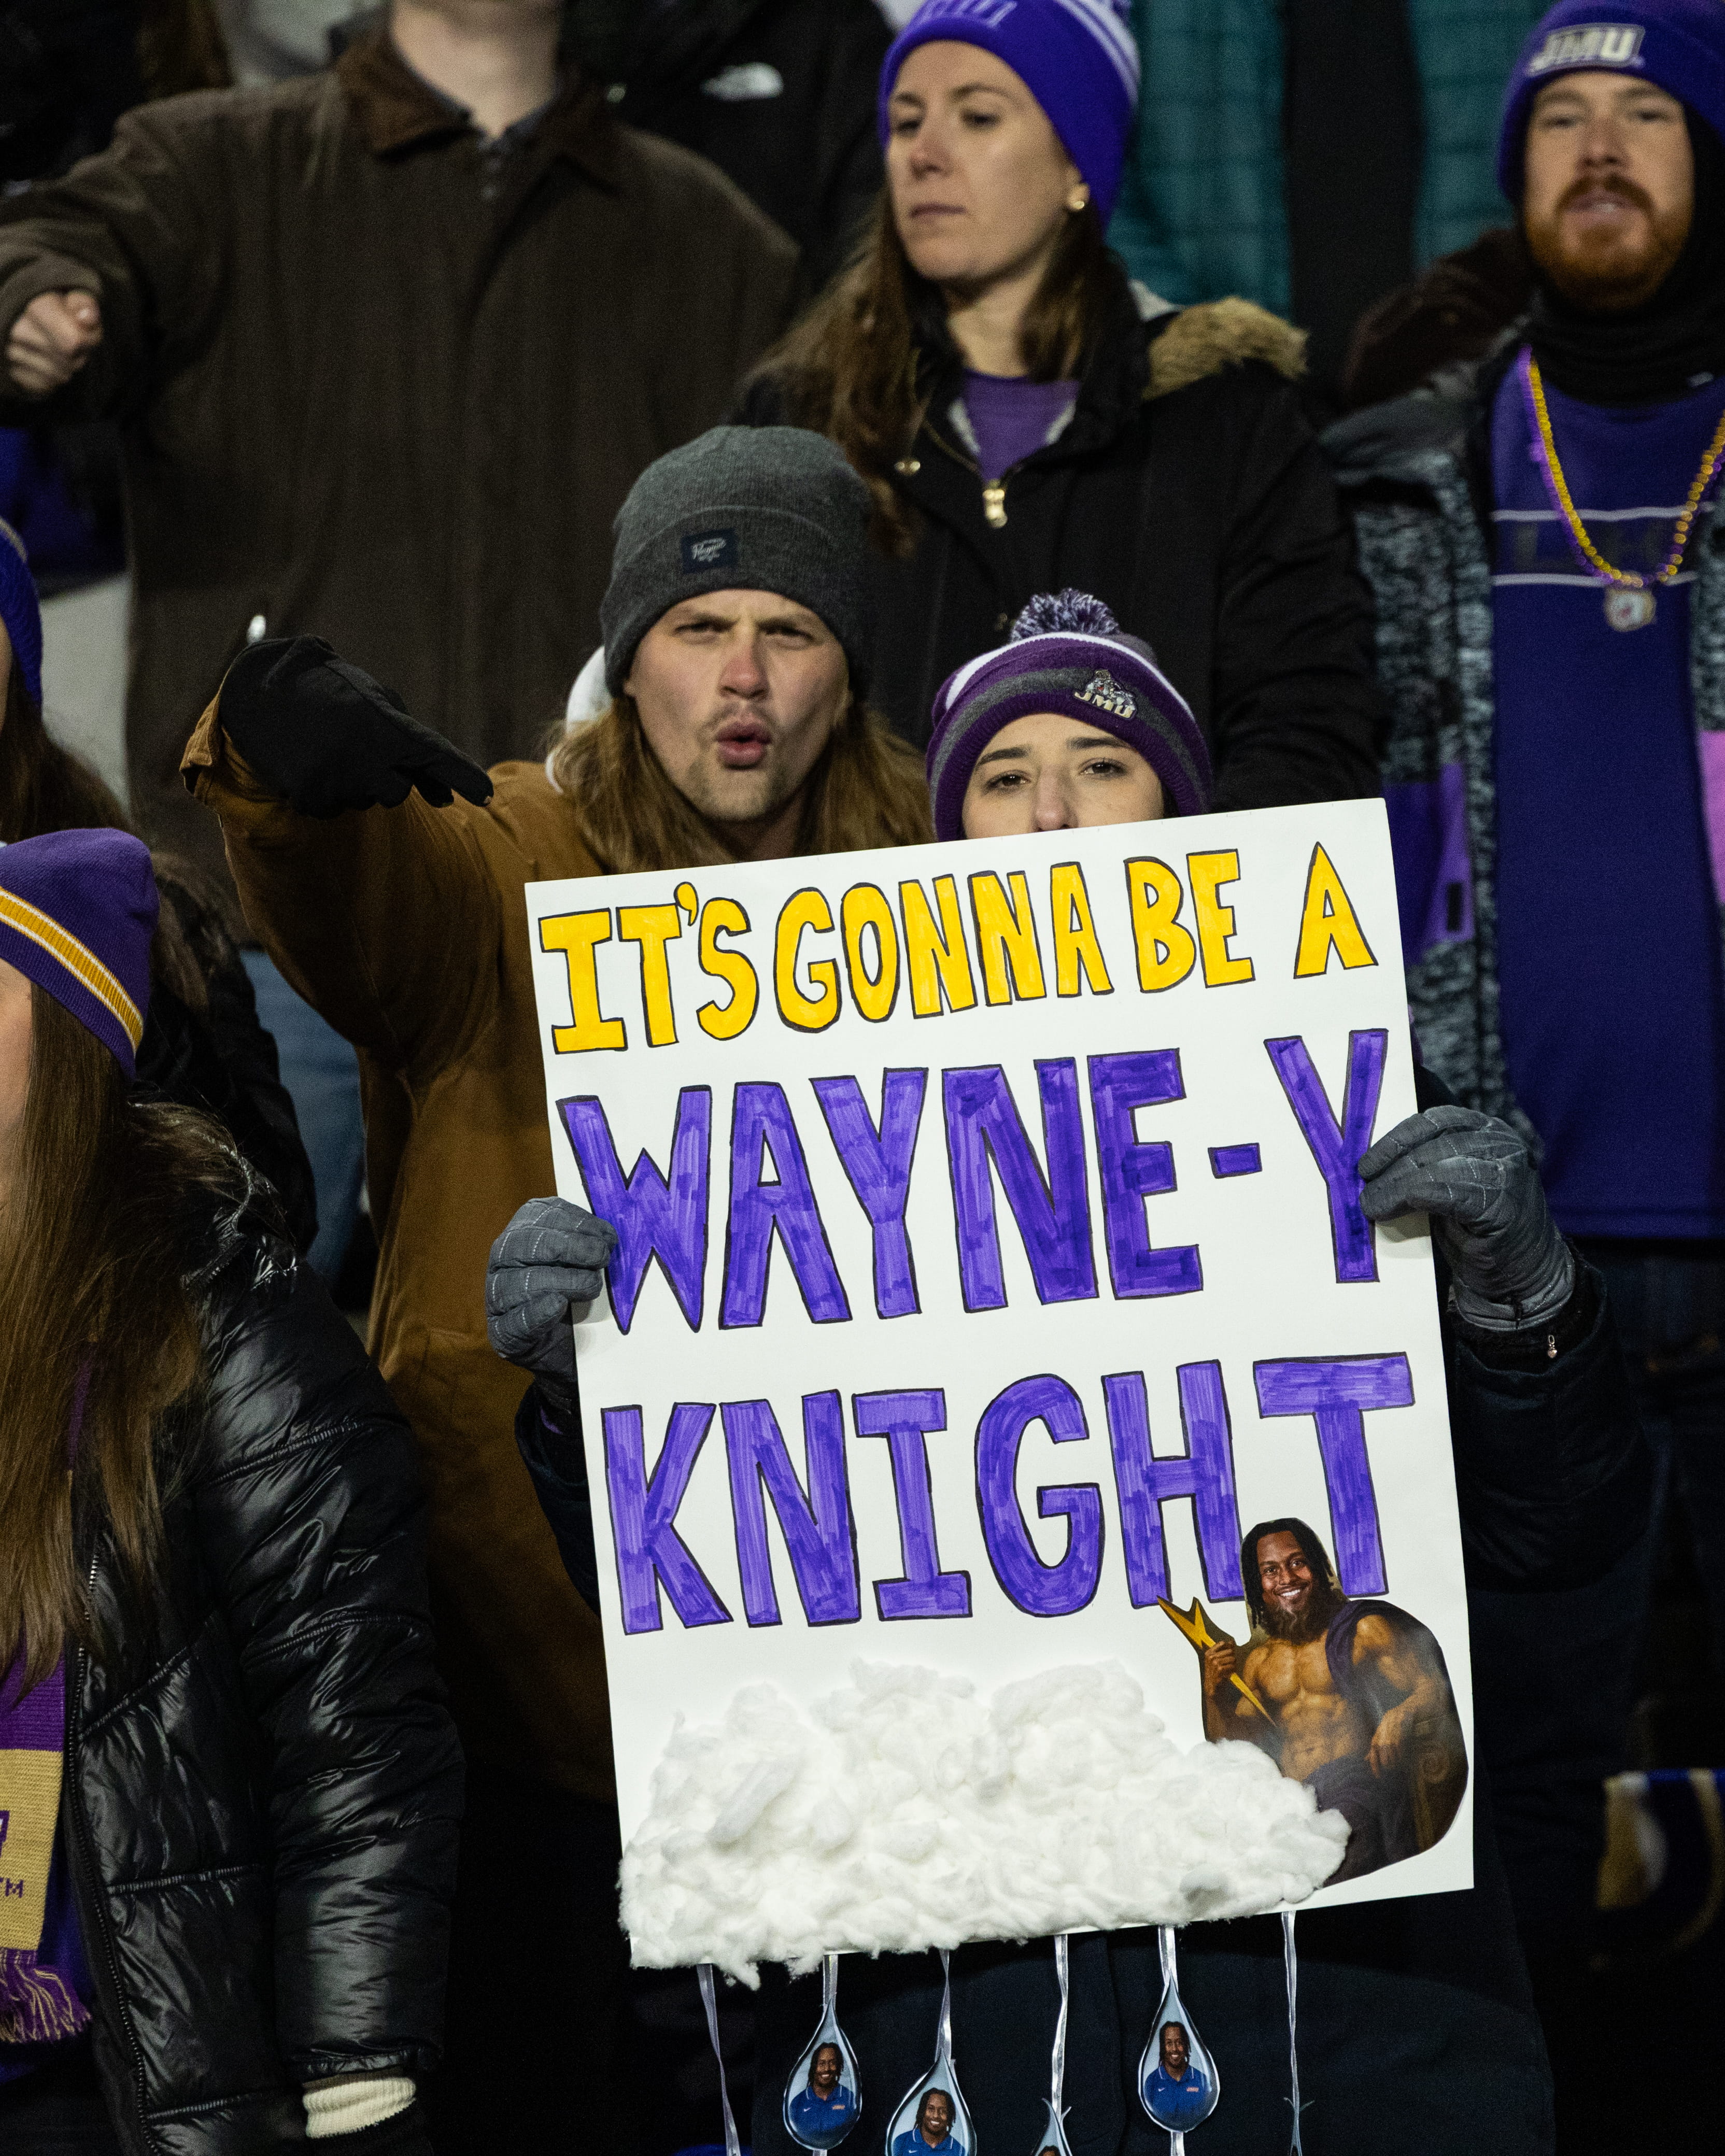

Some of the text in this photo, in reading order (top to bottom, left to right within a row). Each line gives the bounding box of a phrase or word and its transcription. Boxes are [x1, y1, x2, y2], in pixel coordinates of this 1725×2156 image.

[1529, 25, 1641, 75] JMU
[1073, 691, 1135, 719] JMU
[539, 841, 1379, 1054] IT'S GONNA BE A
[555, 1029, 1389, 1335] WAYNE-Y
[600, 1352, 1415, 1636] KNIGHT
